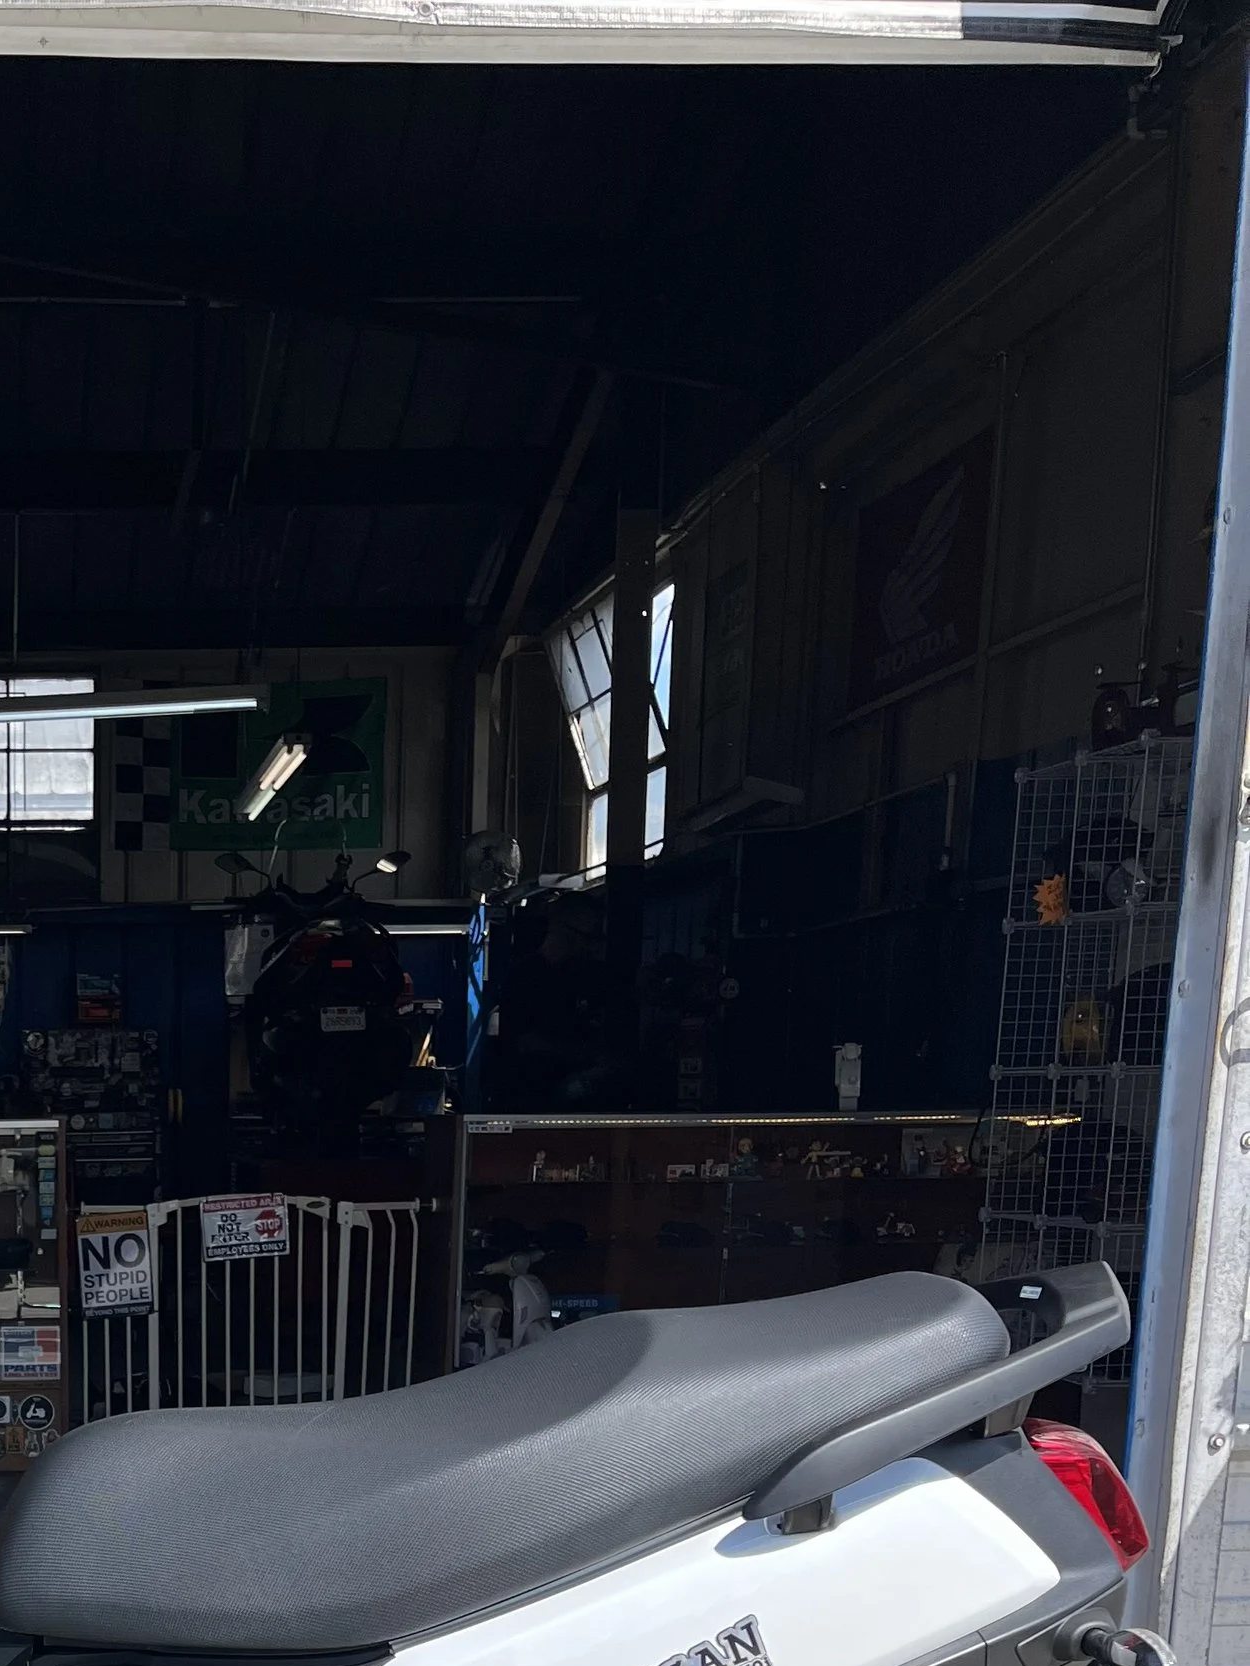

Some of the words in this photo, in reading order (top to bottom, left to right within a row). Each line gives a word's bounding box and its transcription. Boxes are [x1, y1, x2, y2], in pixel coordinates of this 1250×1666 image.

[178, 783, 370, 824] Kaasaki
[203, 1200, 257, 1211] RESTRICTED
[95, 1216, 144, 1229] WARNING
[221, 1213, 237, 1223] DO
[217, 1222, 241, 1233] NOT
[256, 1219, 280, 1231] STOP
[81, 1233, 146, 1271] NO
[207, 1244, 260, 1256] EMPLOYEES
[262, 1242, 285, 1252] ONLY
[84, 1270, 147, 1288] STUPID
[85, 1287, 150, 1305] PEOPLE
[4, 1364, 57, 1372] PARTS
